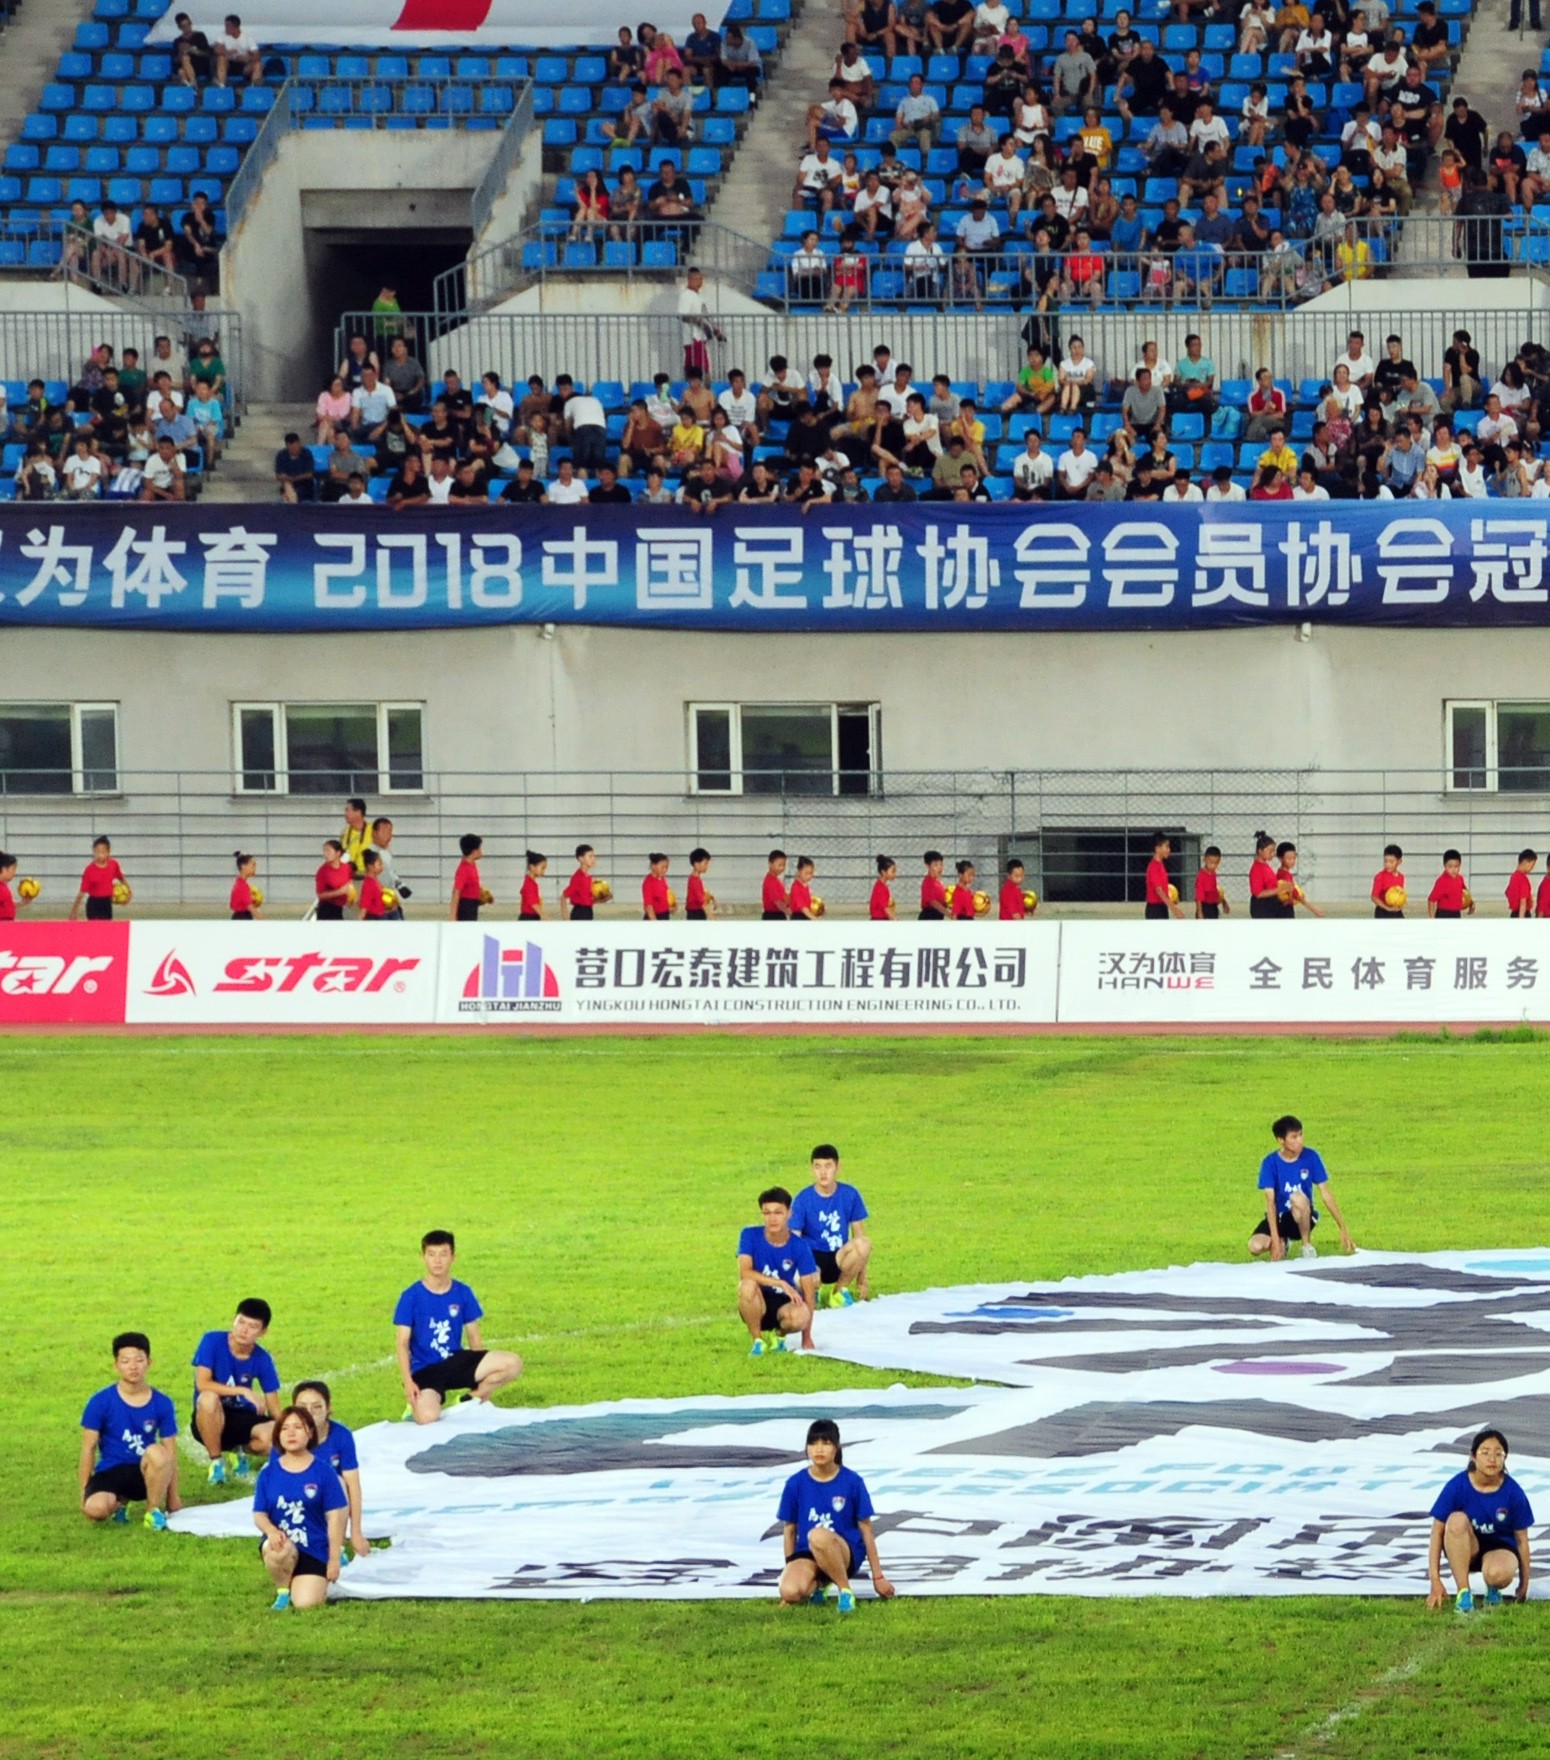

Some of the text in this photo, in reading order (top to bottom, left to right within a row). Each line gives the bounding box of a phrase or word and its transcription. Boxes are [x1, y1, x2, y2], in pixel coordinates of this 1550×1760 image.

[0, 524, 278, 609] 为体育
[575, 947, 1027, 989] 营口宏泰建筑工程有限公司
[1098, 951, 1216, 974] 汉为体育
[1098, 976, 1215, 990] HANWE
[576, 999, 645, 1011] YINGKOU
[649, 999, 719, 1011] HONGTAI
[723, 999, 843, 1011] CONSTRUCTION
[847, 999, 952, 1011] ENGINEERING
